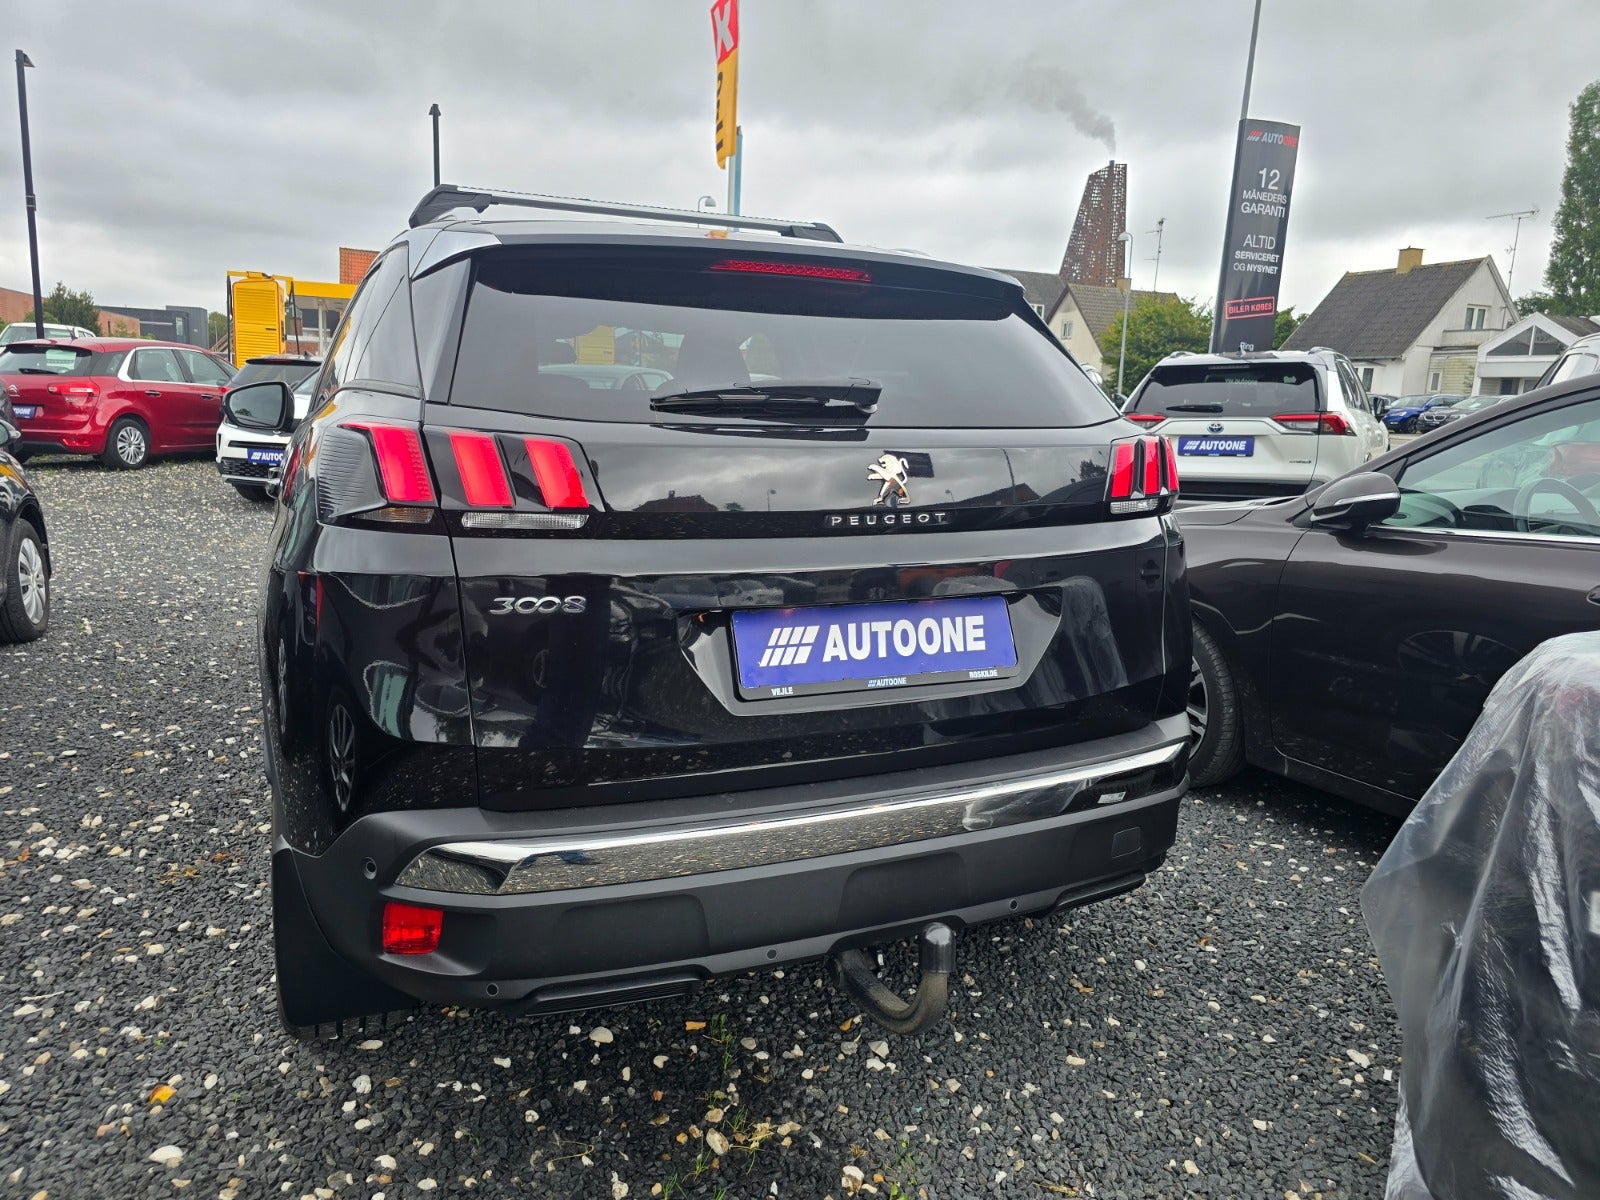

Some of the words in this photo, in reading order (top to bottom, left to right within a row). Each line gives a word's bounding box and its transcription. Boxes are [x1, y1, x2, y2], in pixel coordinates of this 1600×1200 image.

[1261, 132, 1297, 147] AUTOONE
[1259, 168, 1280, 190] 12
[1242, 189, 1287, 204] MÅNEDERS
[1241, 202, 1286, 218] GARANTI
[1243, 234, 1276, 249] ALTID
[1234, 251, 1280, 263] SERVICERET
[1233, 262, 1246, 271] OG
[1246, 263, 1278, 275] NYSYNET
[1228, 305, 1250, 314] BILER
[1199, 440, 1247, 451] AUTOONE
[831, 512, 946, 526] PEUGEOT
[489, 595, 587, 615] 3008
[822, 615, 986, 663] AUTOONE
[771, 686, 793, 696] VEJLE
[876, 677, 907, 687] AUTOONE
[968, 669, 998, 679] ROSKILDE
